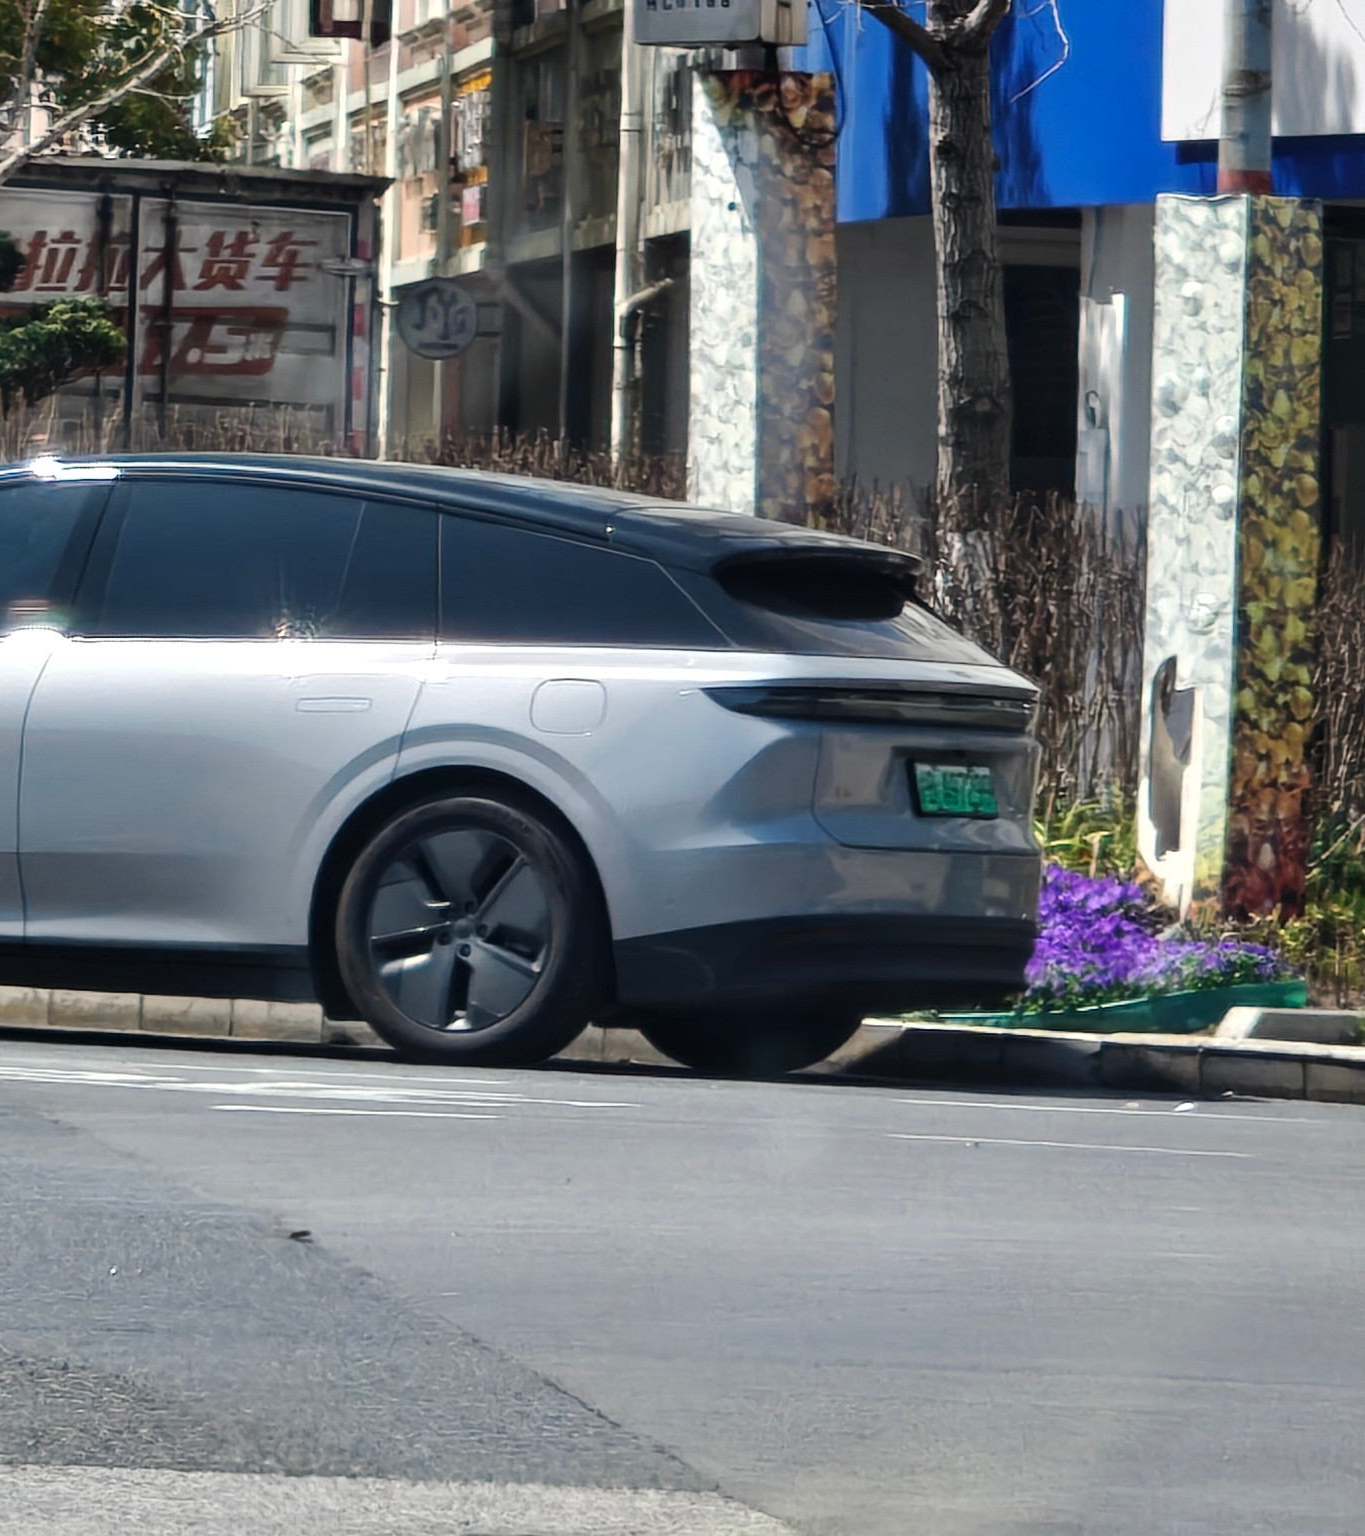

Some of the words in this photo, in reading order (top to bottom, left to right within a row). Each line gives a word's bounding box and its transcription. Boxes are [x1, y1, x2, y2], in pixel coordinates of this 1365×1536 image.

[14, 229, 319, 292] 拉拉大货车
